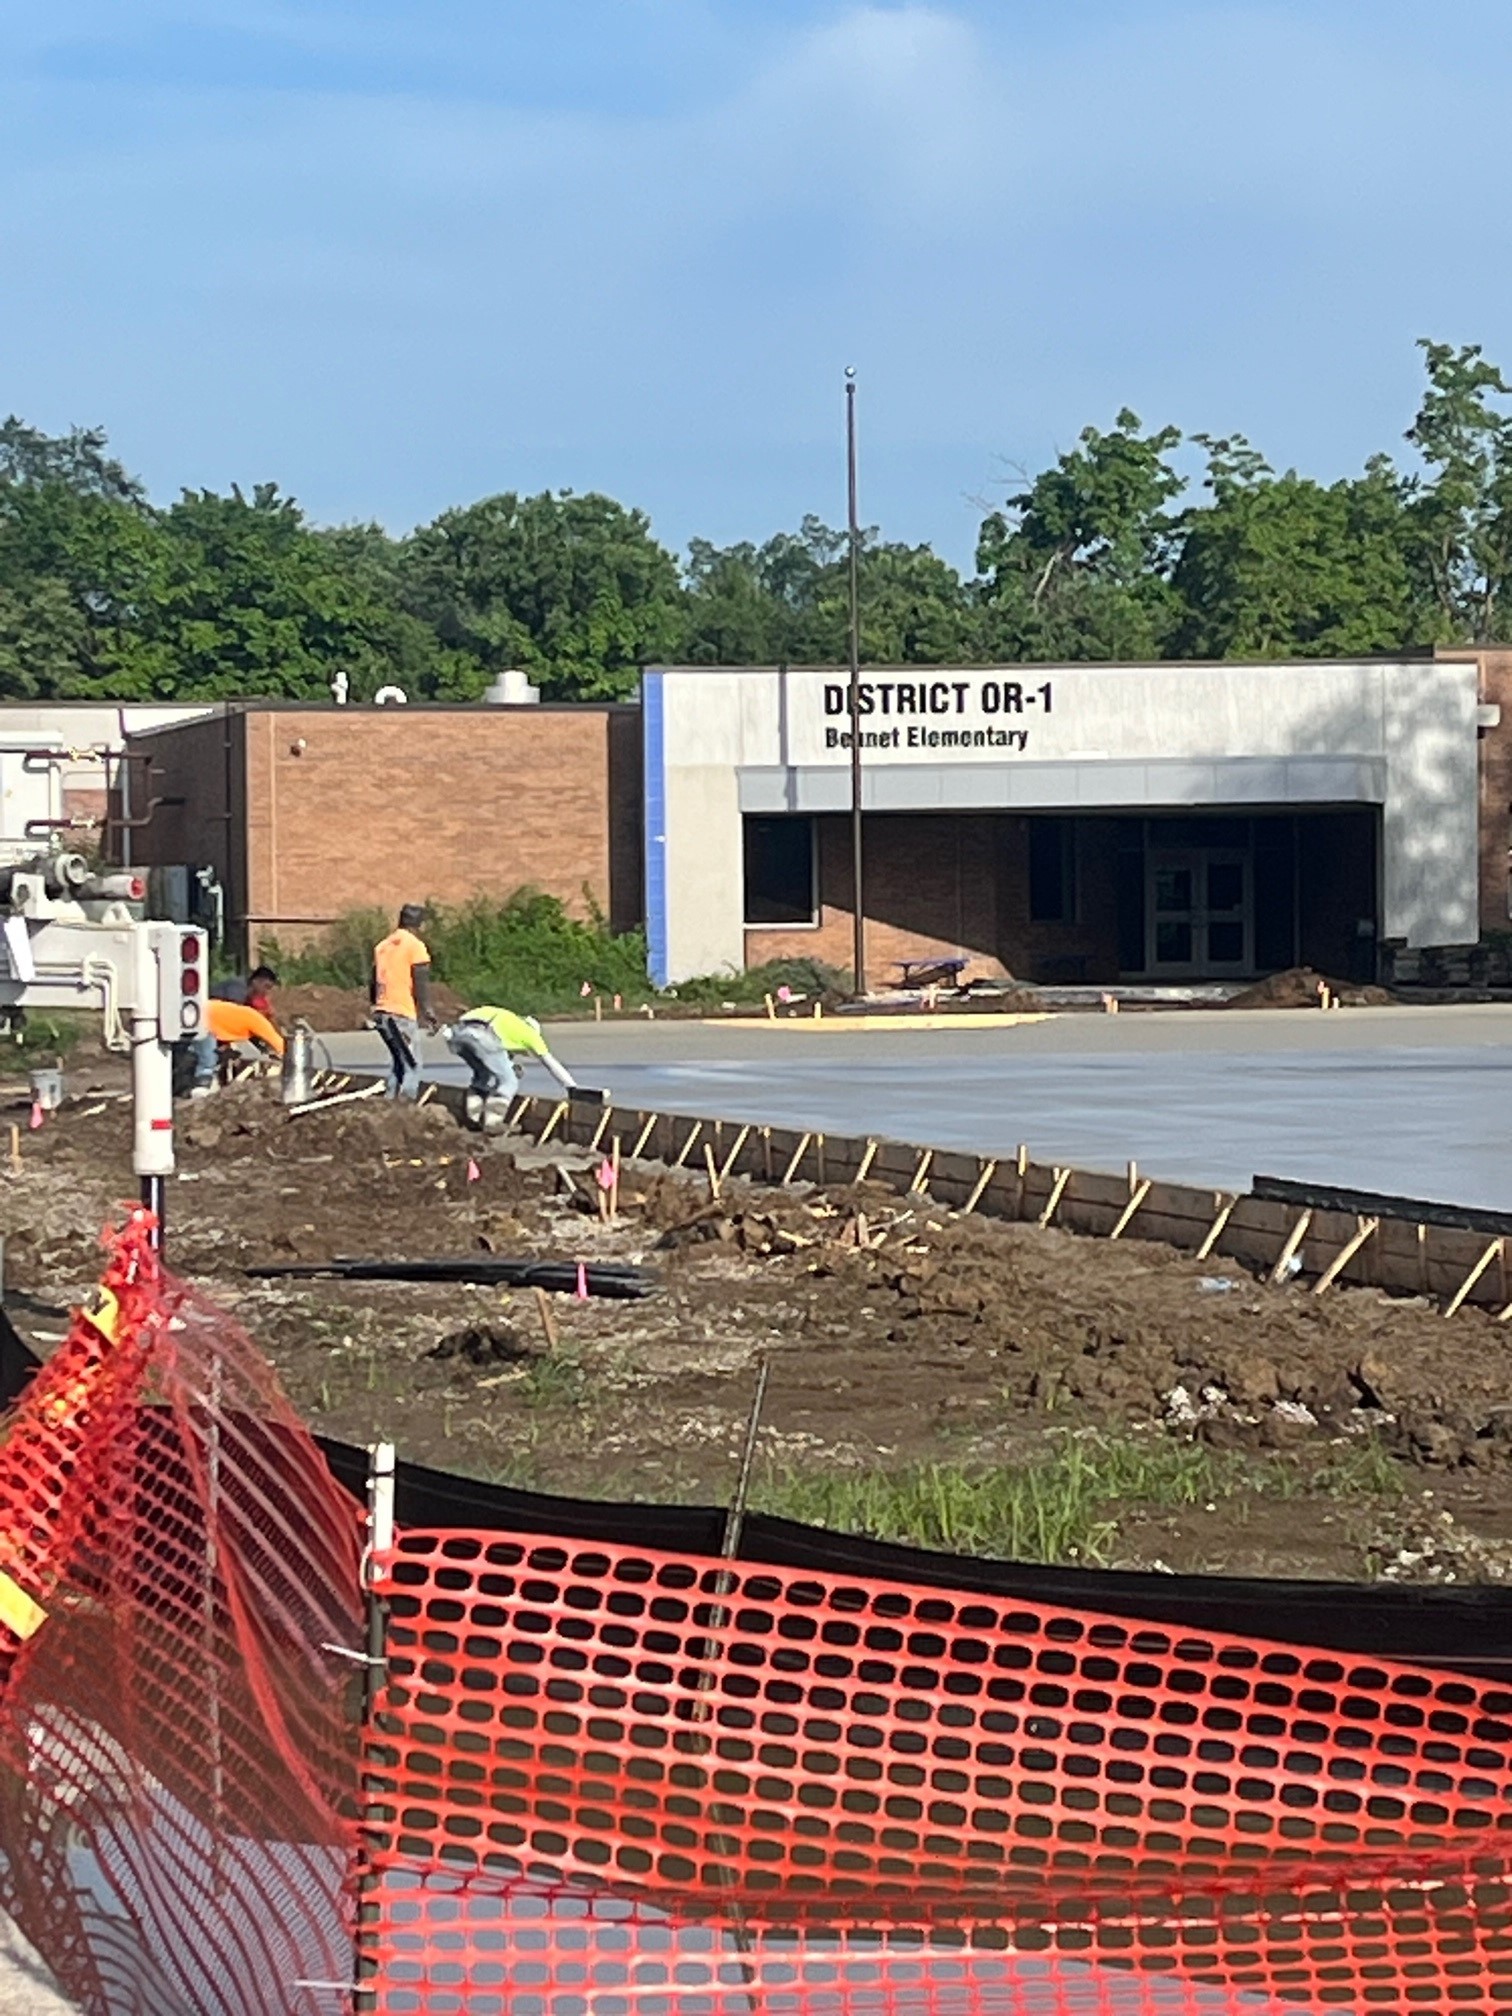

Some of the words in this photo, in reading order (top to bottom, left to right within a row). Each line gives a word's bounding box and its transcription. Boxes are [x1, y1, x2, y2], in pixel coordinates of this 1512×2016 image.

[824, 682, 970, 715] DISTRICT
[981, 681, 1053, 714] OR-1
[907, 725, 1029, 751] Elementary
